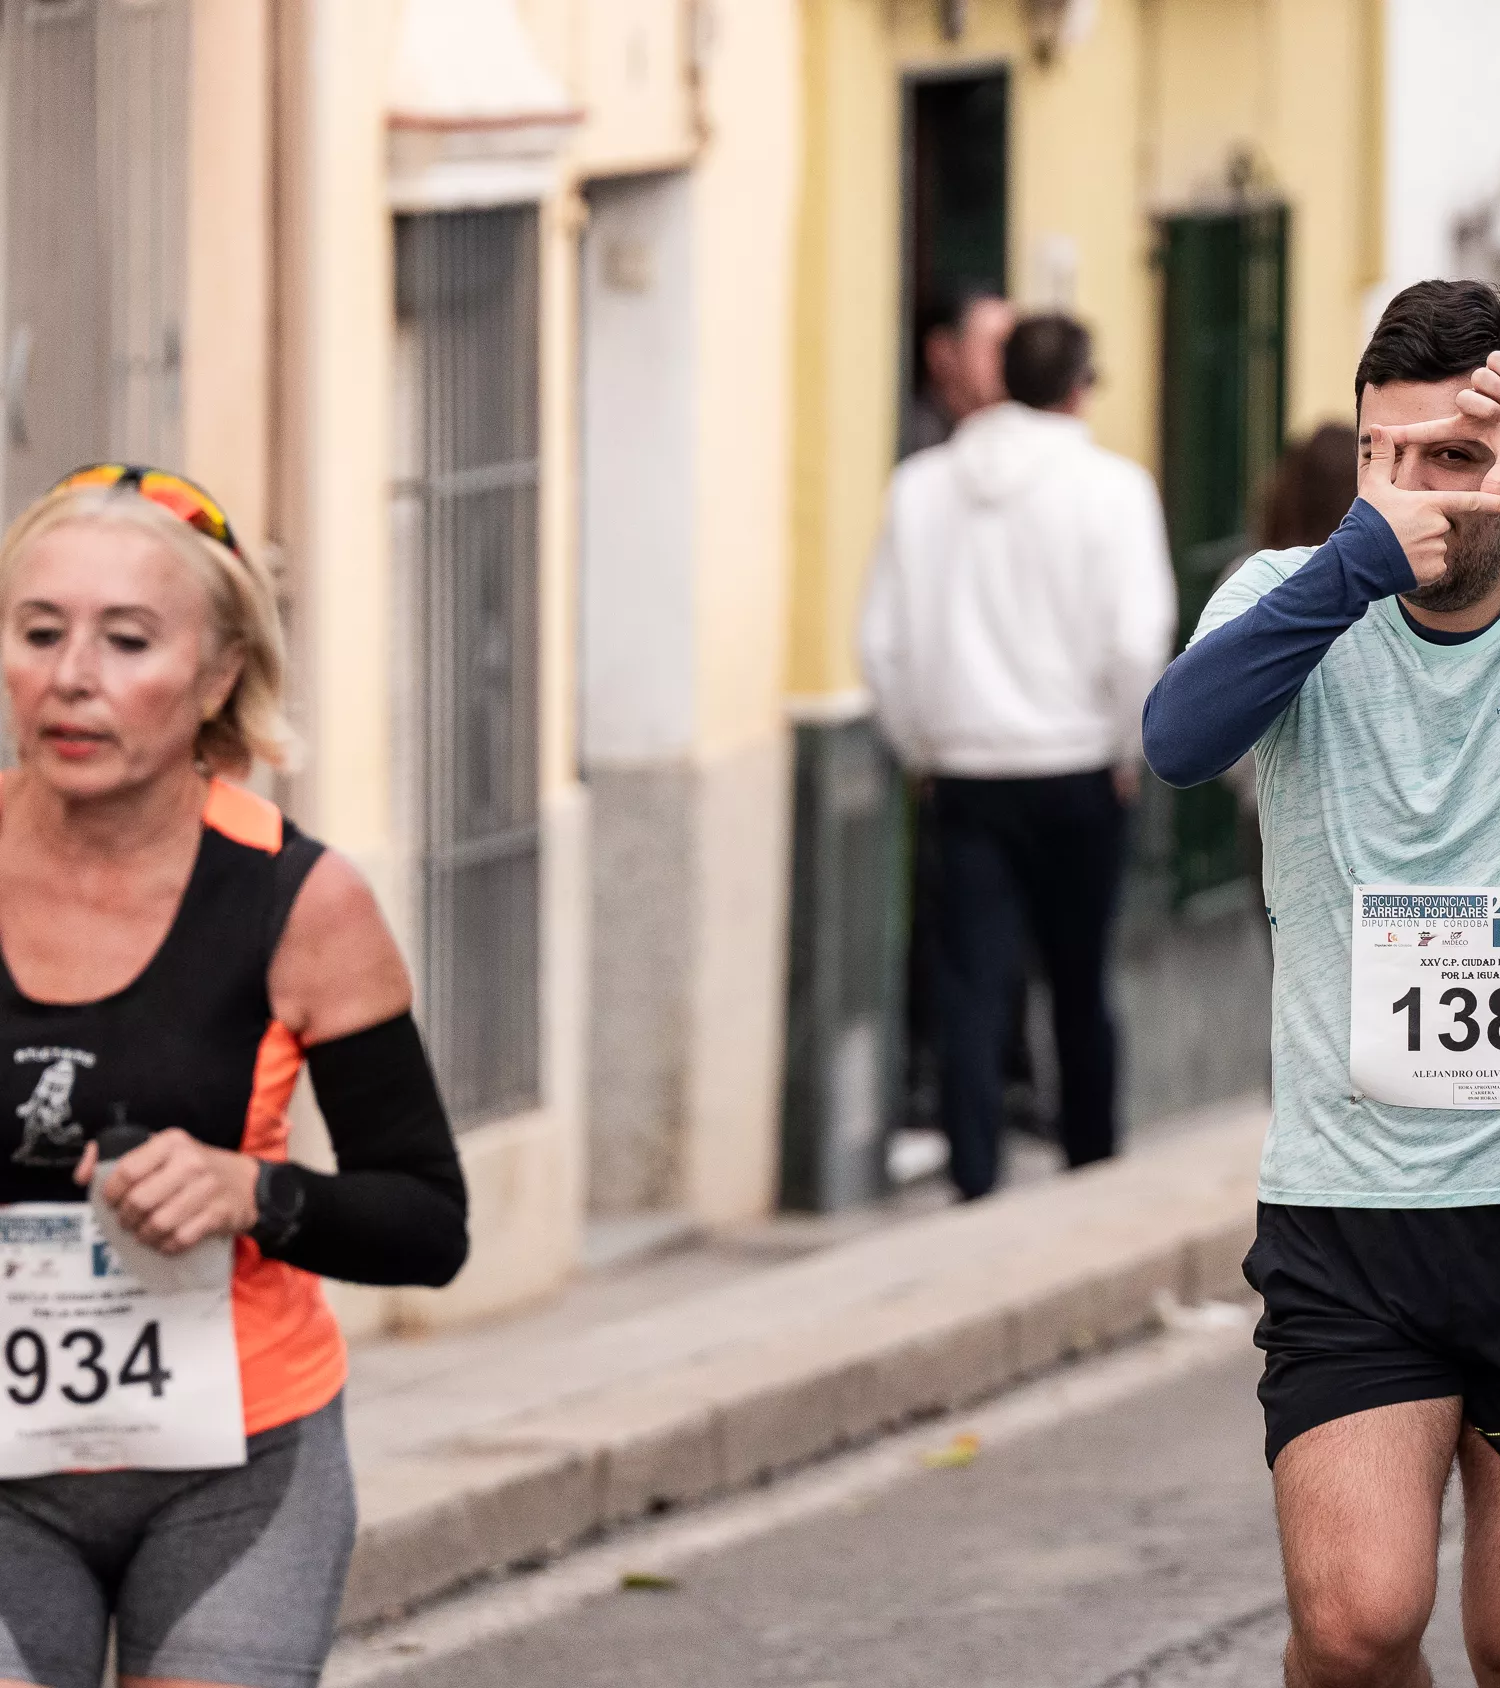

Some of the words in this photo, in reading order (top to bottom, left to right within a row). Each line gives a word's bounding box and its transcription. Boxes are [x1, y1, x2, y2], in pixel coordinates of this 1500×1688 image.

[1362, 896, 1409, 907] CIRCUITO
[1412, 896, 1472, 907] PROVINCIAL
[1475, 896, 1488, 907] DE
[1362, 907, 1420, 918] CARRERAS
[1424, 907, 1488, 918] POPULARES
[1361, 918, 1420, 928] DIPUTACIÓN
[1425, 919, 1437, 928] DE
[1443, 918, 1489, 928] CÓRDOBA
[1420, 957, 1441, 967] XXV
[1442, 958, 1459, 967] C.P.
[1461, 958, 1496, 967] CIUDAD
[1441, 971, 1459, 980] POR
[1462, 971, 1474, 980] LA
[1412, 1069, 1473, 1078] ALEJANDRO
[5, 1319, 172, 1405] 934
